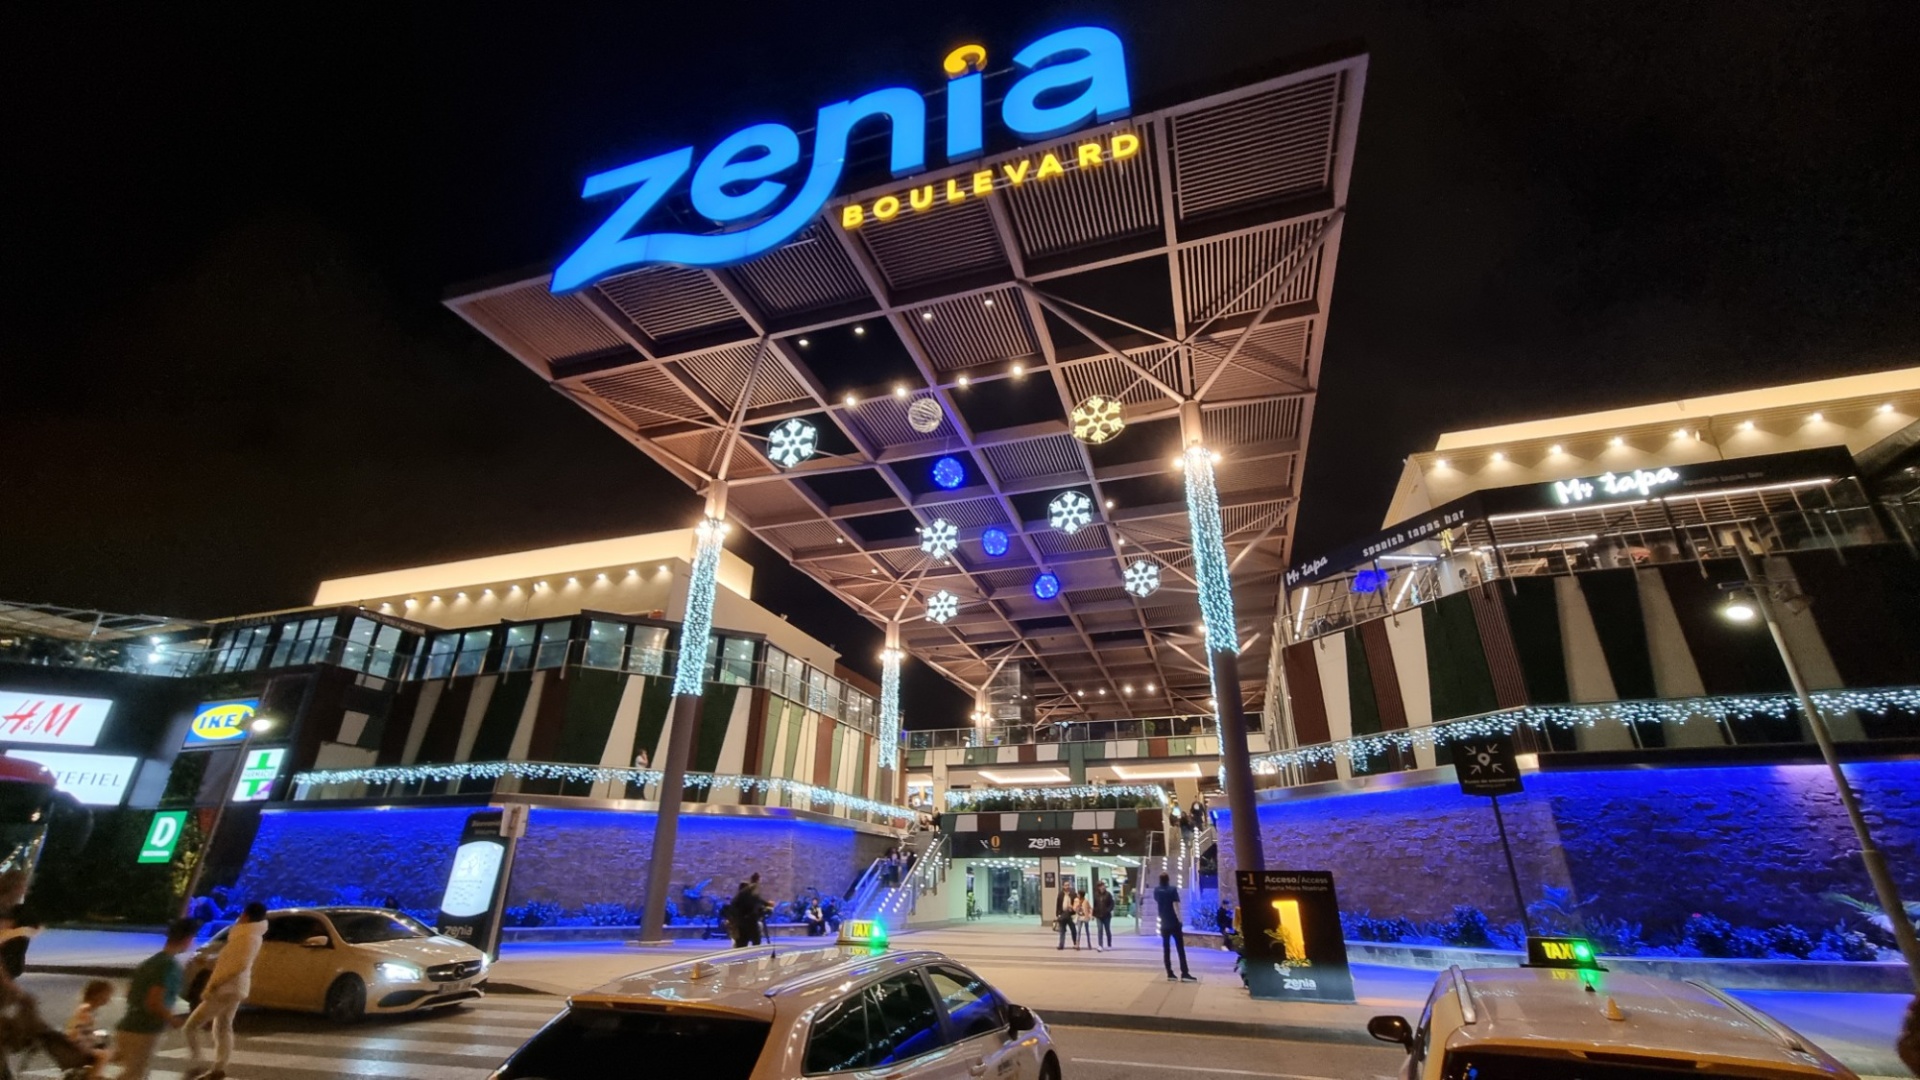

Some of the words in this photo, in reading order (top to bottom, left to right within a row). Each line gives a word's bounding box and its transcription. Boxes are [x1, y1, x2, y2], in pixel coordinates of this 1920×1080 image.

[550, 26, 1131, 294] zenia
[842, 133, 1140, 230] BOULEVARD
[1362, 533, 1404, 558] spanish
[1408, 519, 1440, 540] tapas
[1444, 509, 1465, 524] bar
[1301, 556, 1328, 576] tapa
[0, 700, 83, 737] H&M
[199, 711, 251, 729] IKE
[56, 770, 121, 787] TEFIEL
[150, 816, 177, 848] D
[991, 835, 1000, 847] 0
[1028, 837, 1061, 849] zenia
[1541, 942, 1577, 959] TAXI
[1283, 978, 1317, 990] zenia
